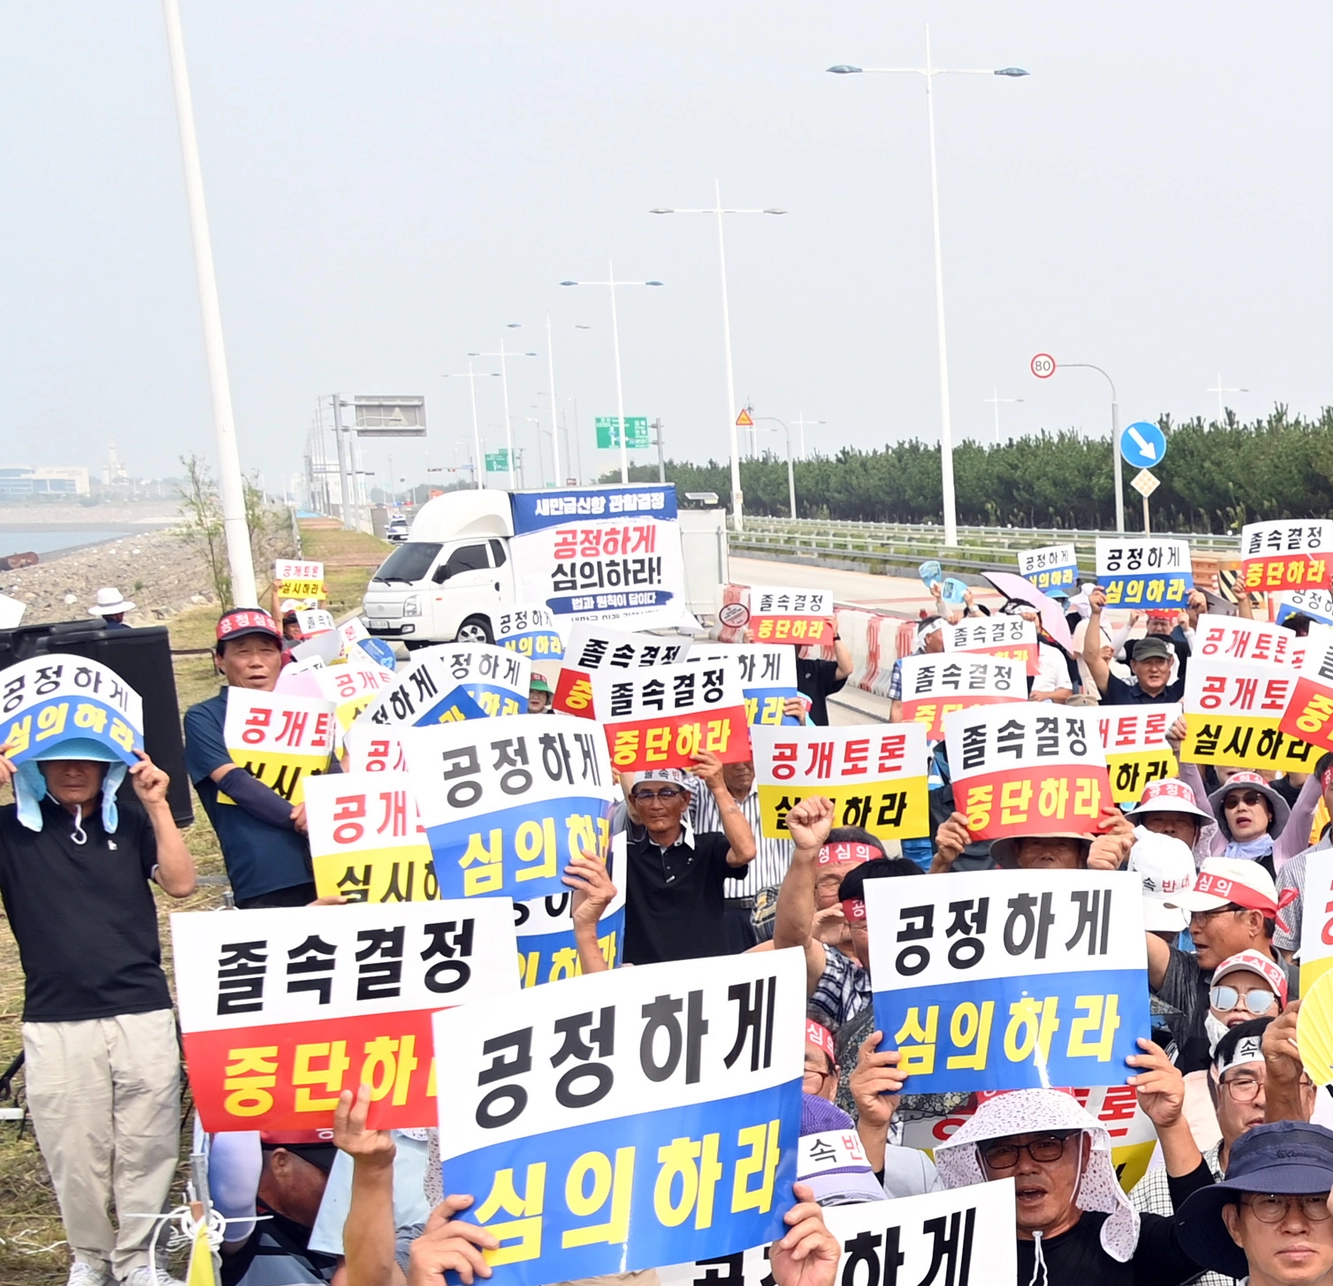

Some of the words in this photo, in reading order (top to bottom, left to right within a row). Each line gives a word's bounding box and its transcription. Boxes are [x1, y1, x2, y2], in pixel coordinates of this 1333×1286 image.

[1035, 360, 1051, 371] 80
[553, 525, 656, 560] 공정하게
[1106, 546, 1181, 571] 공정하게
[1248, 526, 1323, 554] 졸속결정
[283, 565, 318, 577] 공개토론
[551, 557, 662, 592] 심의하라!
[1025, 550, 1069, 571] 공정하게
[1244, 559, 1327, 588] 중단하라
[760, 594, 823, 612] 졸속결정
[1105, 578, 1186, 604] 심의하라
[757, 620, 825, 641] 중단하라
[954, 620, 1024, 648] 졸속결정
[1201, 627, 1289, 664] 공개토론
[441, 653, 521, 686] 정하게
[914, 662, 1013, 694] 졸속결정
[3, 665, 129, 714] 공정하게
[370, 664, 439, 726] 정하게
[611, 668, 724, 717] 졸속결정
[1199, 675, 1289, 710] 공개토
[4, 703, 135, 758] 심의하라
[241, 707, 331, 748] 공개토
[612, 718, 731, 766] 중단하라
[961, 716, 1089, 771] 졸속결정
[442, 732, 602, 809] 공정하게
[772, 734, 907, 781] 공개토론
[965, 776, 1102, 833] 중단하라
[1148, 783, 1195, 800] 공정심
[331, 790, 426, 845] 공개
[774, 791, 908, 831] 실하라
[817, 843, 869, 864] 정심의
[335, 858, 440, 903] 실시하
[1198, 874, 1234, 897] 심의
[895, 888, 1112, 977] 공정하게
[215, 918, 477, 1017] 졸속결정
[475, 974, 778, 1131] 공정하게
[893, 993, 1121, 1078] 심의하라
[222, 1029, 436, 1119] 중단하
[809, 1135, 864, 1164] 속반
[475, 1118, 781, 1267] 심의하라
